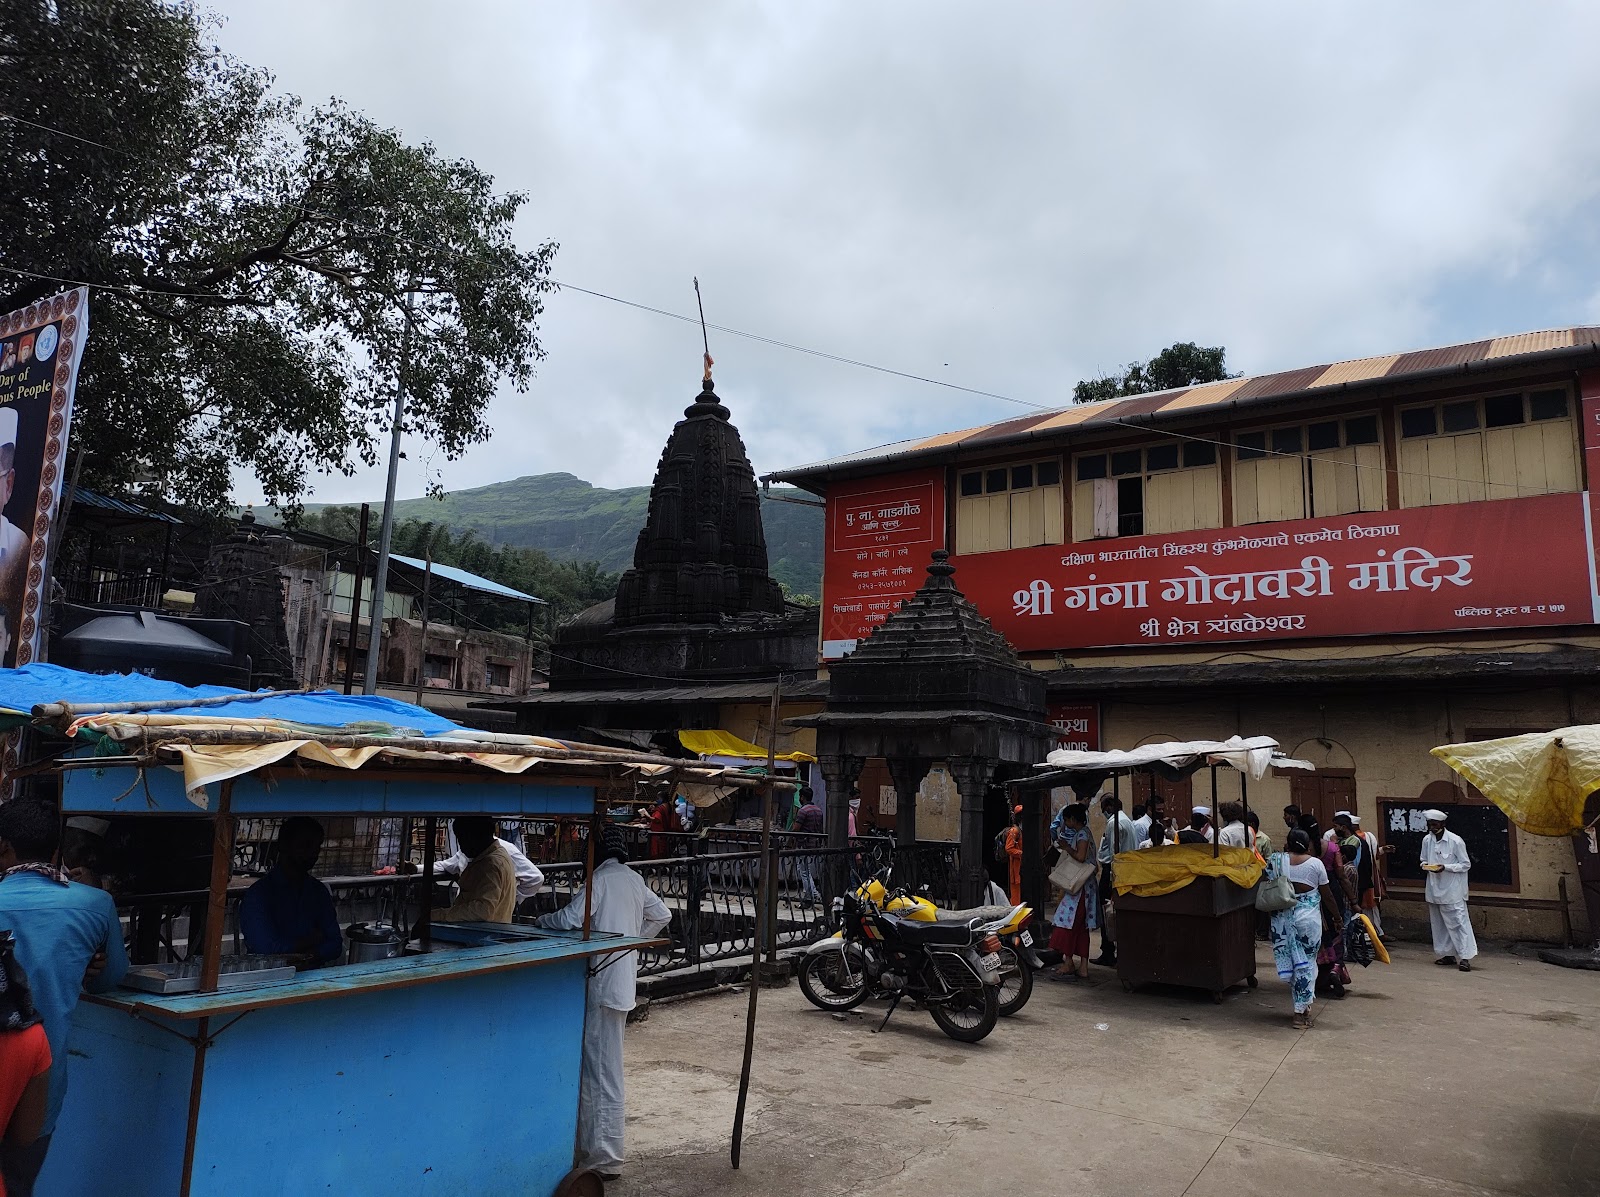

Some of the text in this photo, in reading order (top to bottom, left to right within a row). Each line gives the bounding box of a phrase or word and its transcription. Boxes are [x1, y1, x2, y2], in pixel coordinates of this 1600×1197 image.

[0, 366, 30, 389] Day of
[0, 379, 52, 404] ous People
[861, 521, 879, 531] आणि
[1061, 552, 1095, 567] दक्षिण
[1098, 545, 1159, 562] भारतातील
[1162, 542, 1208, 557] सिंहस्थ
[1294, 527, 1343, 545] एकमेव
[1347, 524, 1401, 540] ठिकाण
[856, 551, 868, 561] सोने
[876, 549, 890, 559] चांदी
[892, 566, 913, 575] नाशिक
[1012, 546, 1474, 617] श्री गंगा गोदावरी मंदिर
[868, 599, 890, 611] पासपोर्ट
[1454, 606, 1492, 617] पब्लिक
[1494, 606, 1518, 618] ट्रस्ट
[1549, 604, 1566, 612] ७७
[865, 613, 886, 623] नाशिक
[1140, 612, 1306, 638] श्री क्षेत्र त्र्यंबकेश्वर
[1057, 742, 1089, 752] ANDIR
